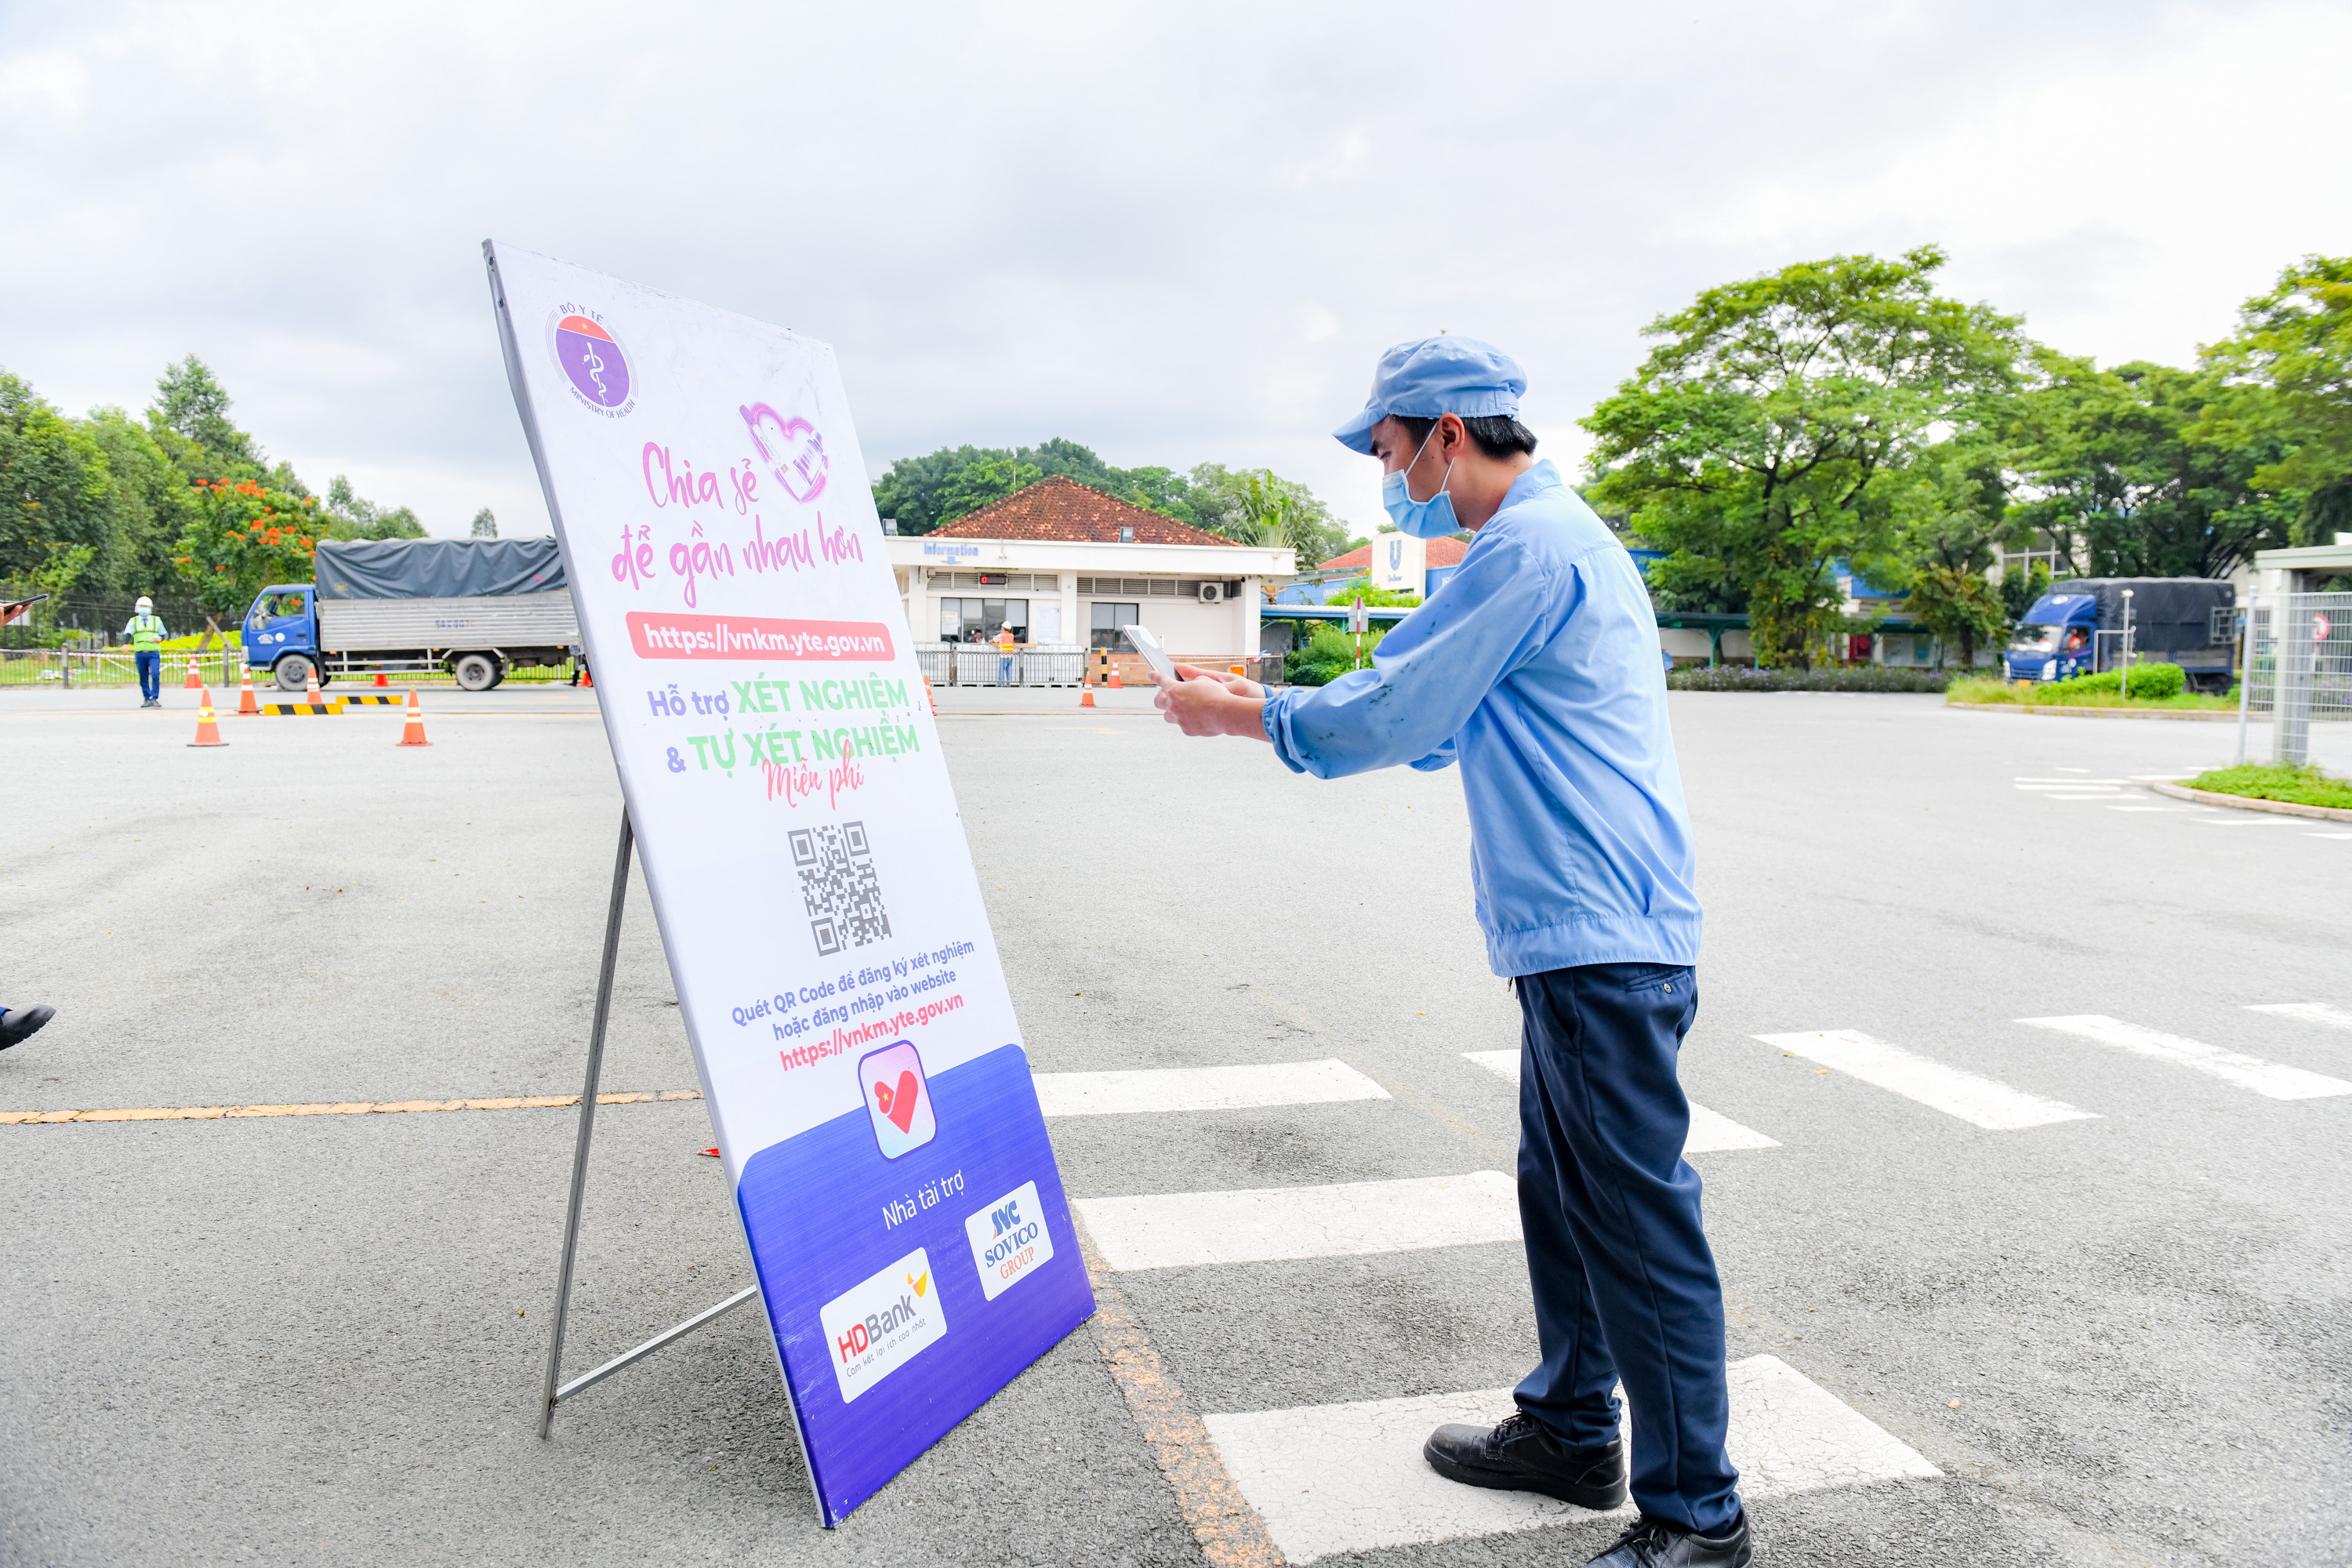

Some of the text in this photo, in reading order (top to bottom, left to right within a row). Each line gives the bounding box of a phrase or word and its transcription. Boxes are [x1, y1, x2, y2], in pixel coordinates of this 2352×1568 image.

[579, 304, 586, 314] Y
[570, 386, 636, 419] MINISTRY OF HEALTH
[642, 441, 760, 516] Chia sẻ
[612, 510, 864, 609] để gần nhau hơn
[924, 542, 979, 556] Information
[644, 623, 886, 655] https://vnkm.yte.gov.vn
[647, 671, 910, 721] Hỗ trợ XÉT NGHIỆM
[666, 717, 920, 779] & TỰ XÉT NGHIỆM
[761, 739, 865, 811] Miễn phí
[732, 941, 975, 1027] Quét QR Code để đăng ký xét nghiệm
[772, 969, 956, 1041] hoặc đăng nhập vào website
[779, 994, 964, 1072] https://vnkm.yte.gov.vn
[882, 1169, 964, 1230] Nhà tài trợ
[985, 1221, 1038, 1269] SOVICO
[1000, 1246, 1034, 1279] GROUP
[837, 1294, 916, 1364] HDBank
[846, 1363, 862, 1377] Cam
[898, 1330, 910, 1342] cao
